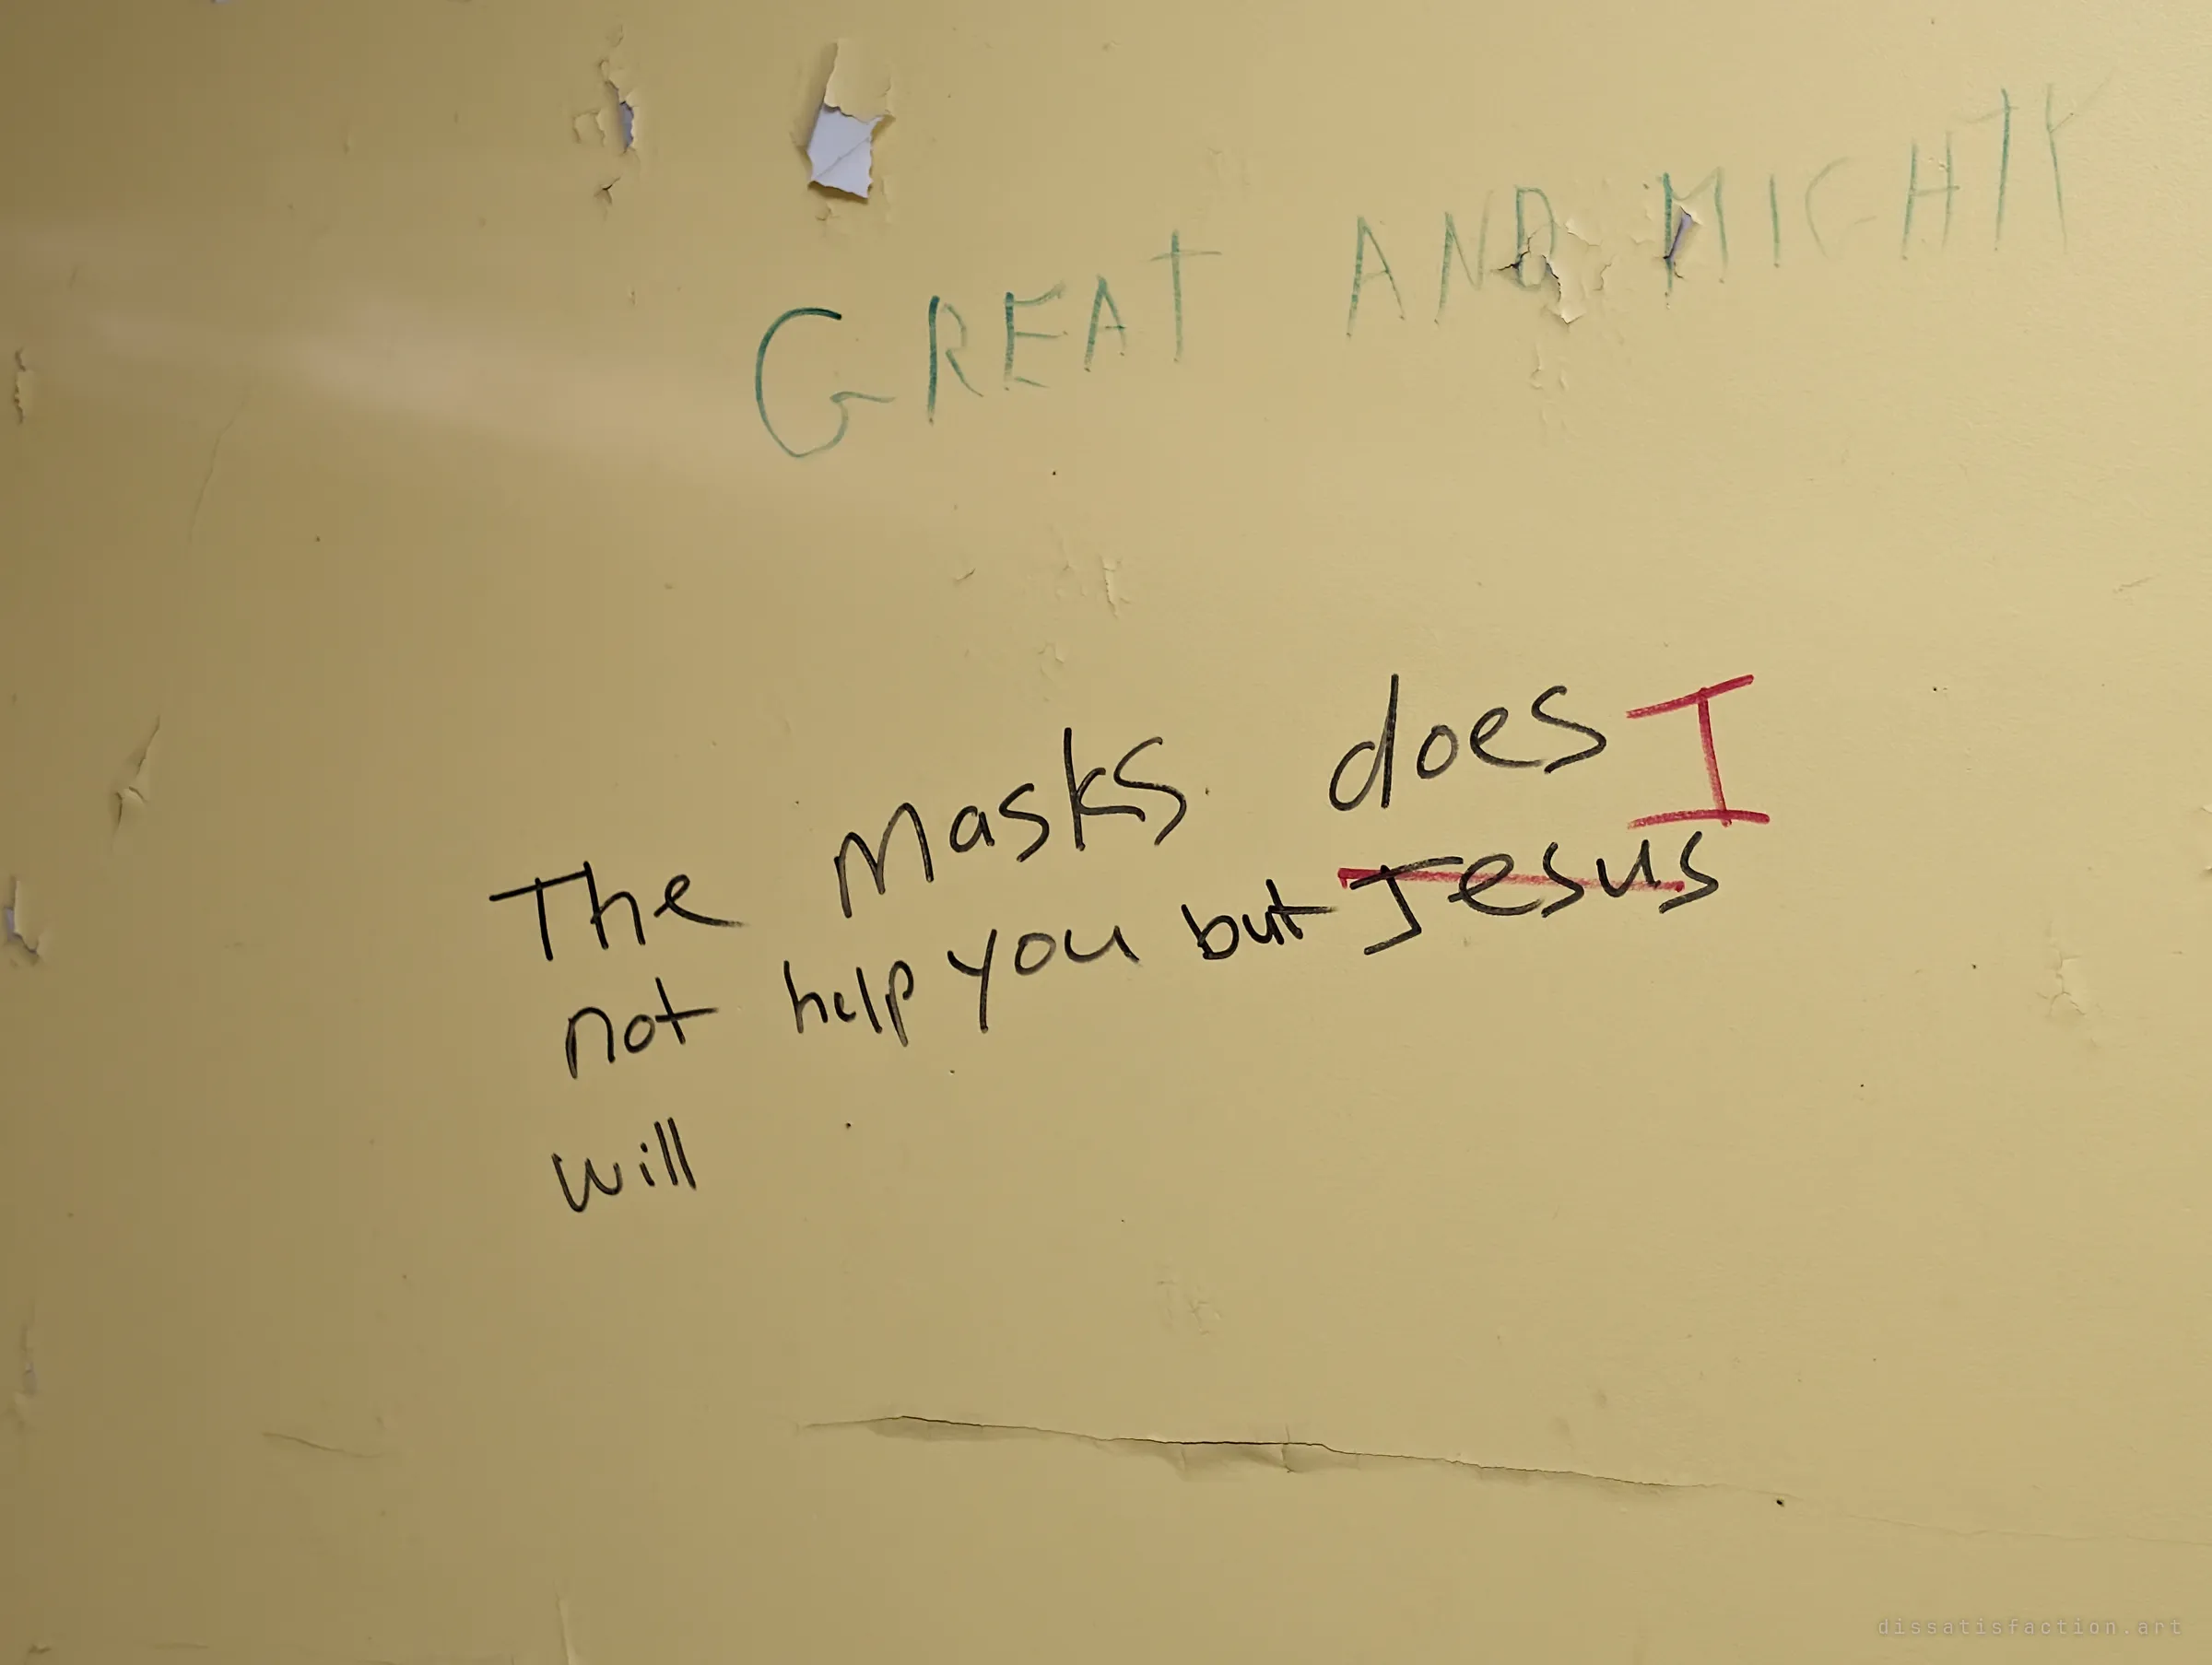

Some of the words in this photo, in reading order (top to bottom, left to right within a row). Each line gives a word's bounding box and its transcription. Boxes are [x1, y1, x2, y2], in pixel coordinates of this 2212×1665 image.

[755, 229, 1222, 458] GREAT
[1345, 186, 1557, 338] AND
[488, 861, 743, 961] The
[1328, 674, 1607, 812] does
[1626, 674, 1771, 827] I
[564, 977, 719, 1079] not
[782, 960, 915, 1047] help
[947, 925, 1139, 1034] you
[1181, 878, 1338, 960] but
[1348, 830, 1720, 956] Jesus
[551, 1118, 697, 1214] will
